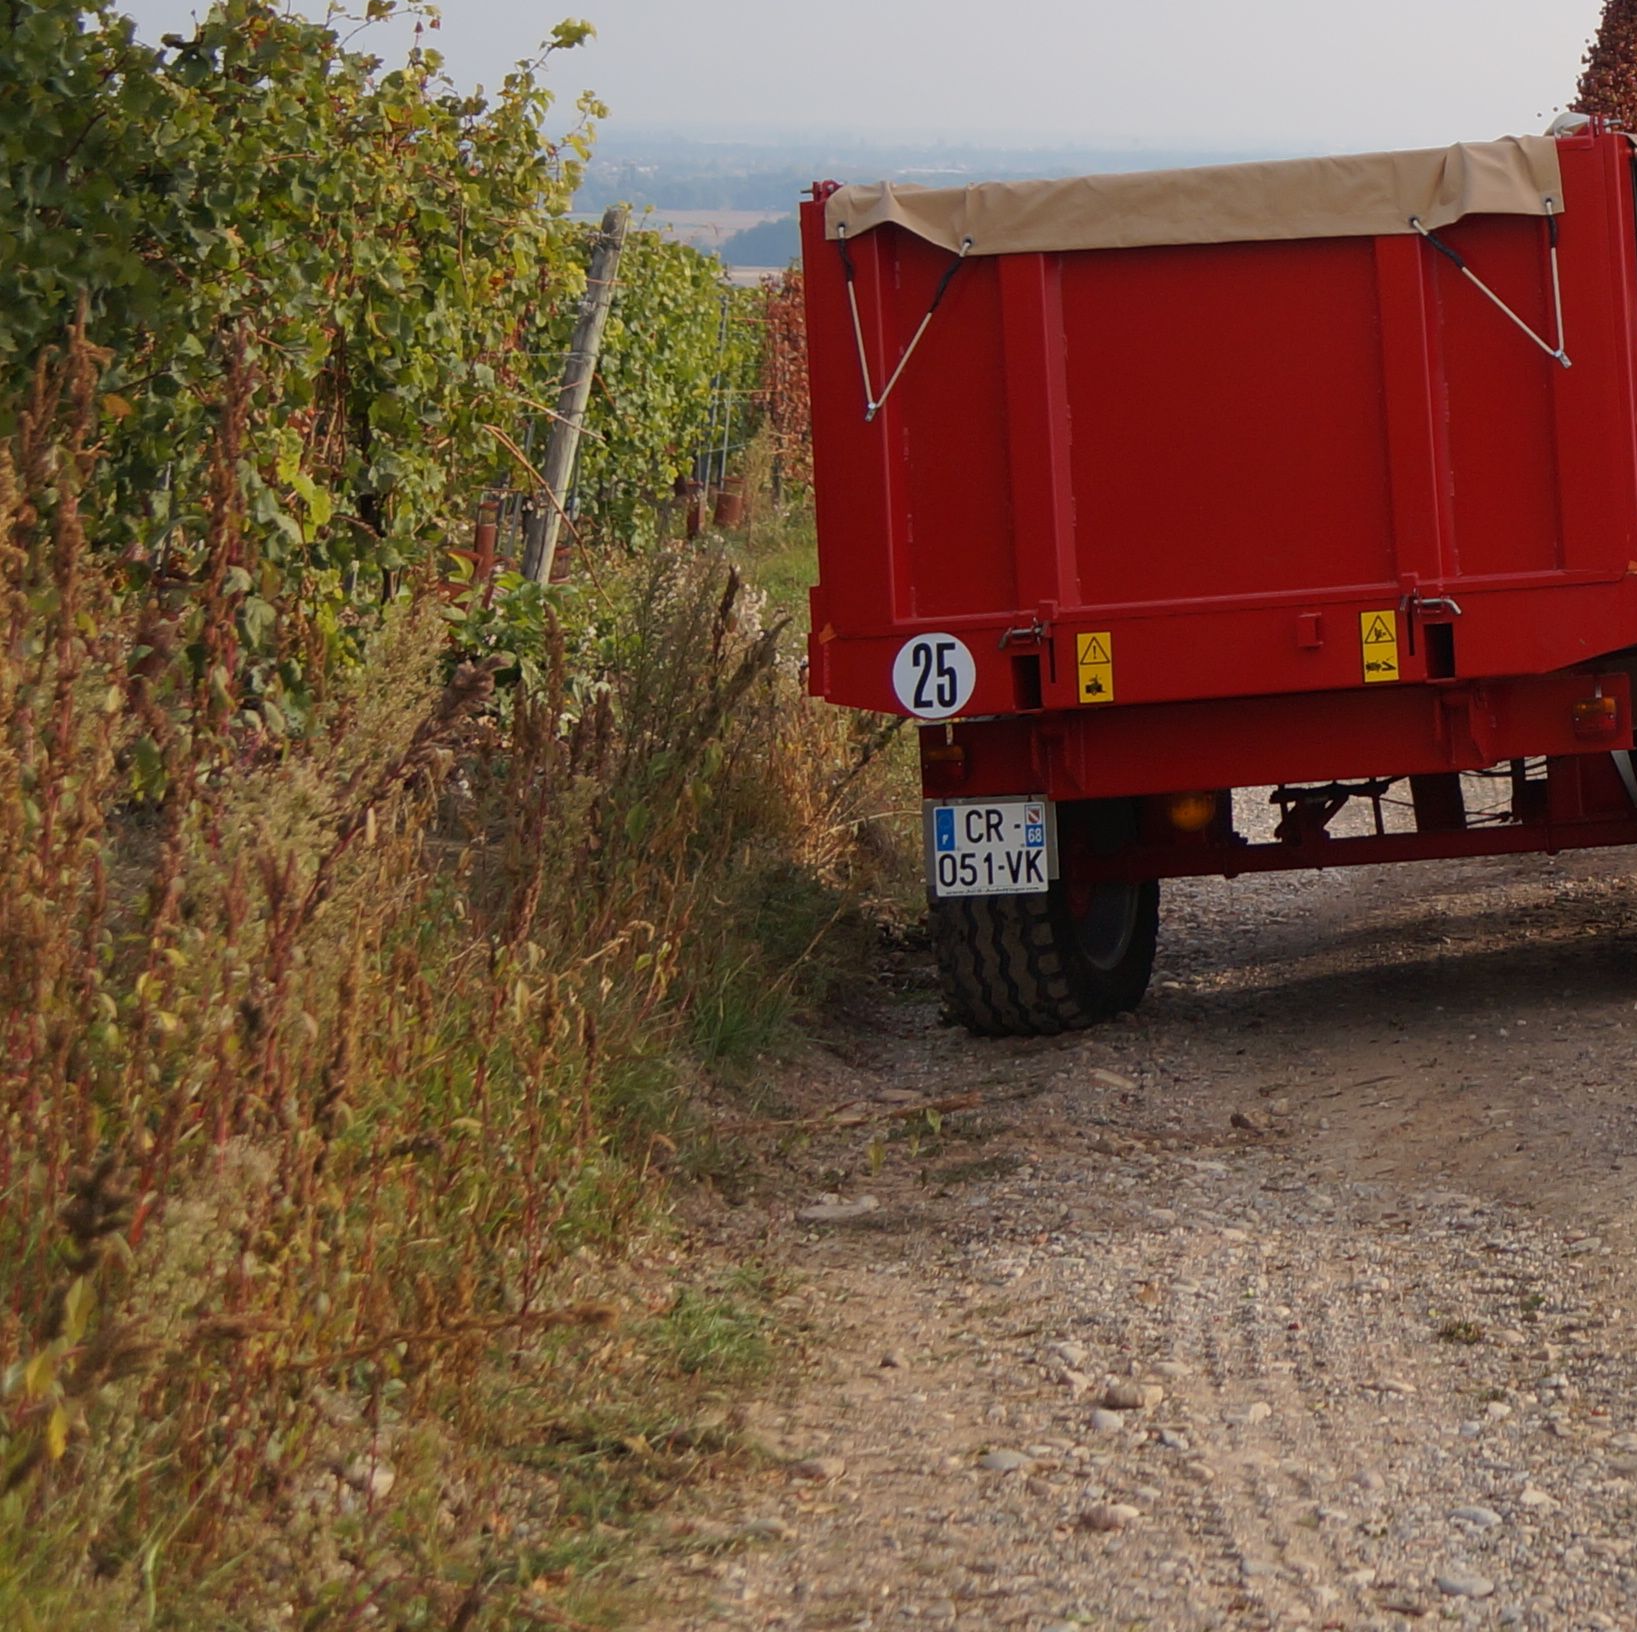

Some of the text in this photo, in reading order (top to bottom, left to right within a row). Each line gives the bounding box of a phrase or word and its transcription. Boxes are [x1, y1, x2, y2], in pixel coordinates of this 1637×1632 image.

[913, 643, 957, 708] 25
[1027, 827, 1042, 843] 68
[939, 850, 1044, 887] 051-VK
